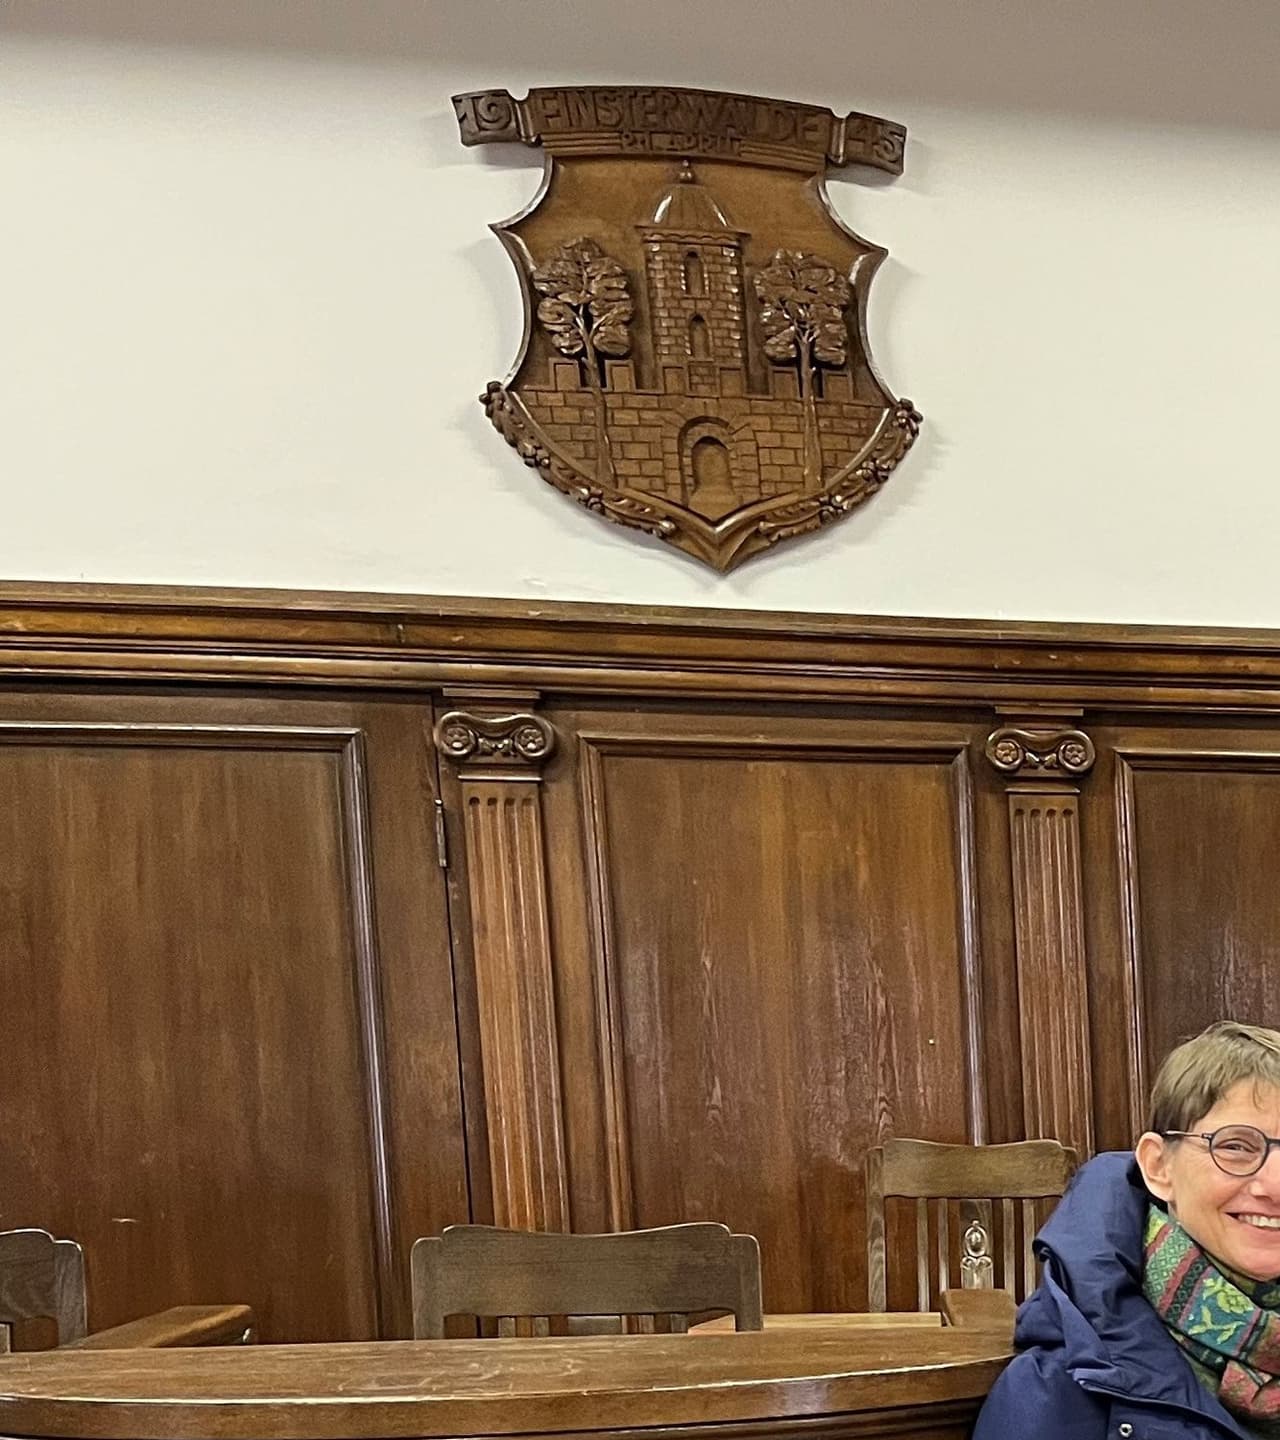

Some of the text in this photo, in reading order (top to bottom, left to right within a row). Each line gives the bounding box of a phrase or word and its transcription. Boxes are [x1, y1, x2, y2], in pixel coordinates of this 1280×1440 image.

[455, 89, 906, 165] 19 FINSTERWALDE 45
